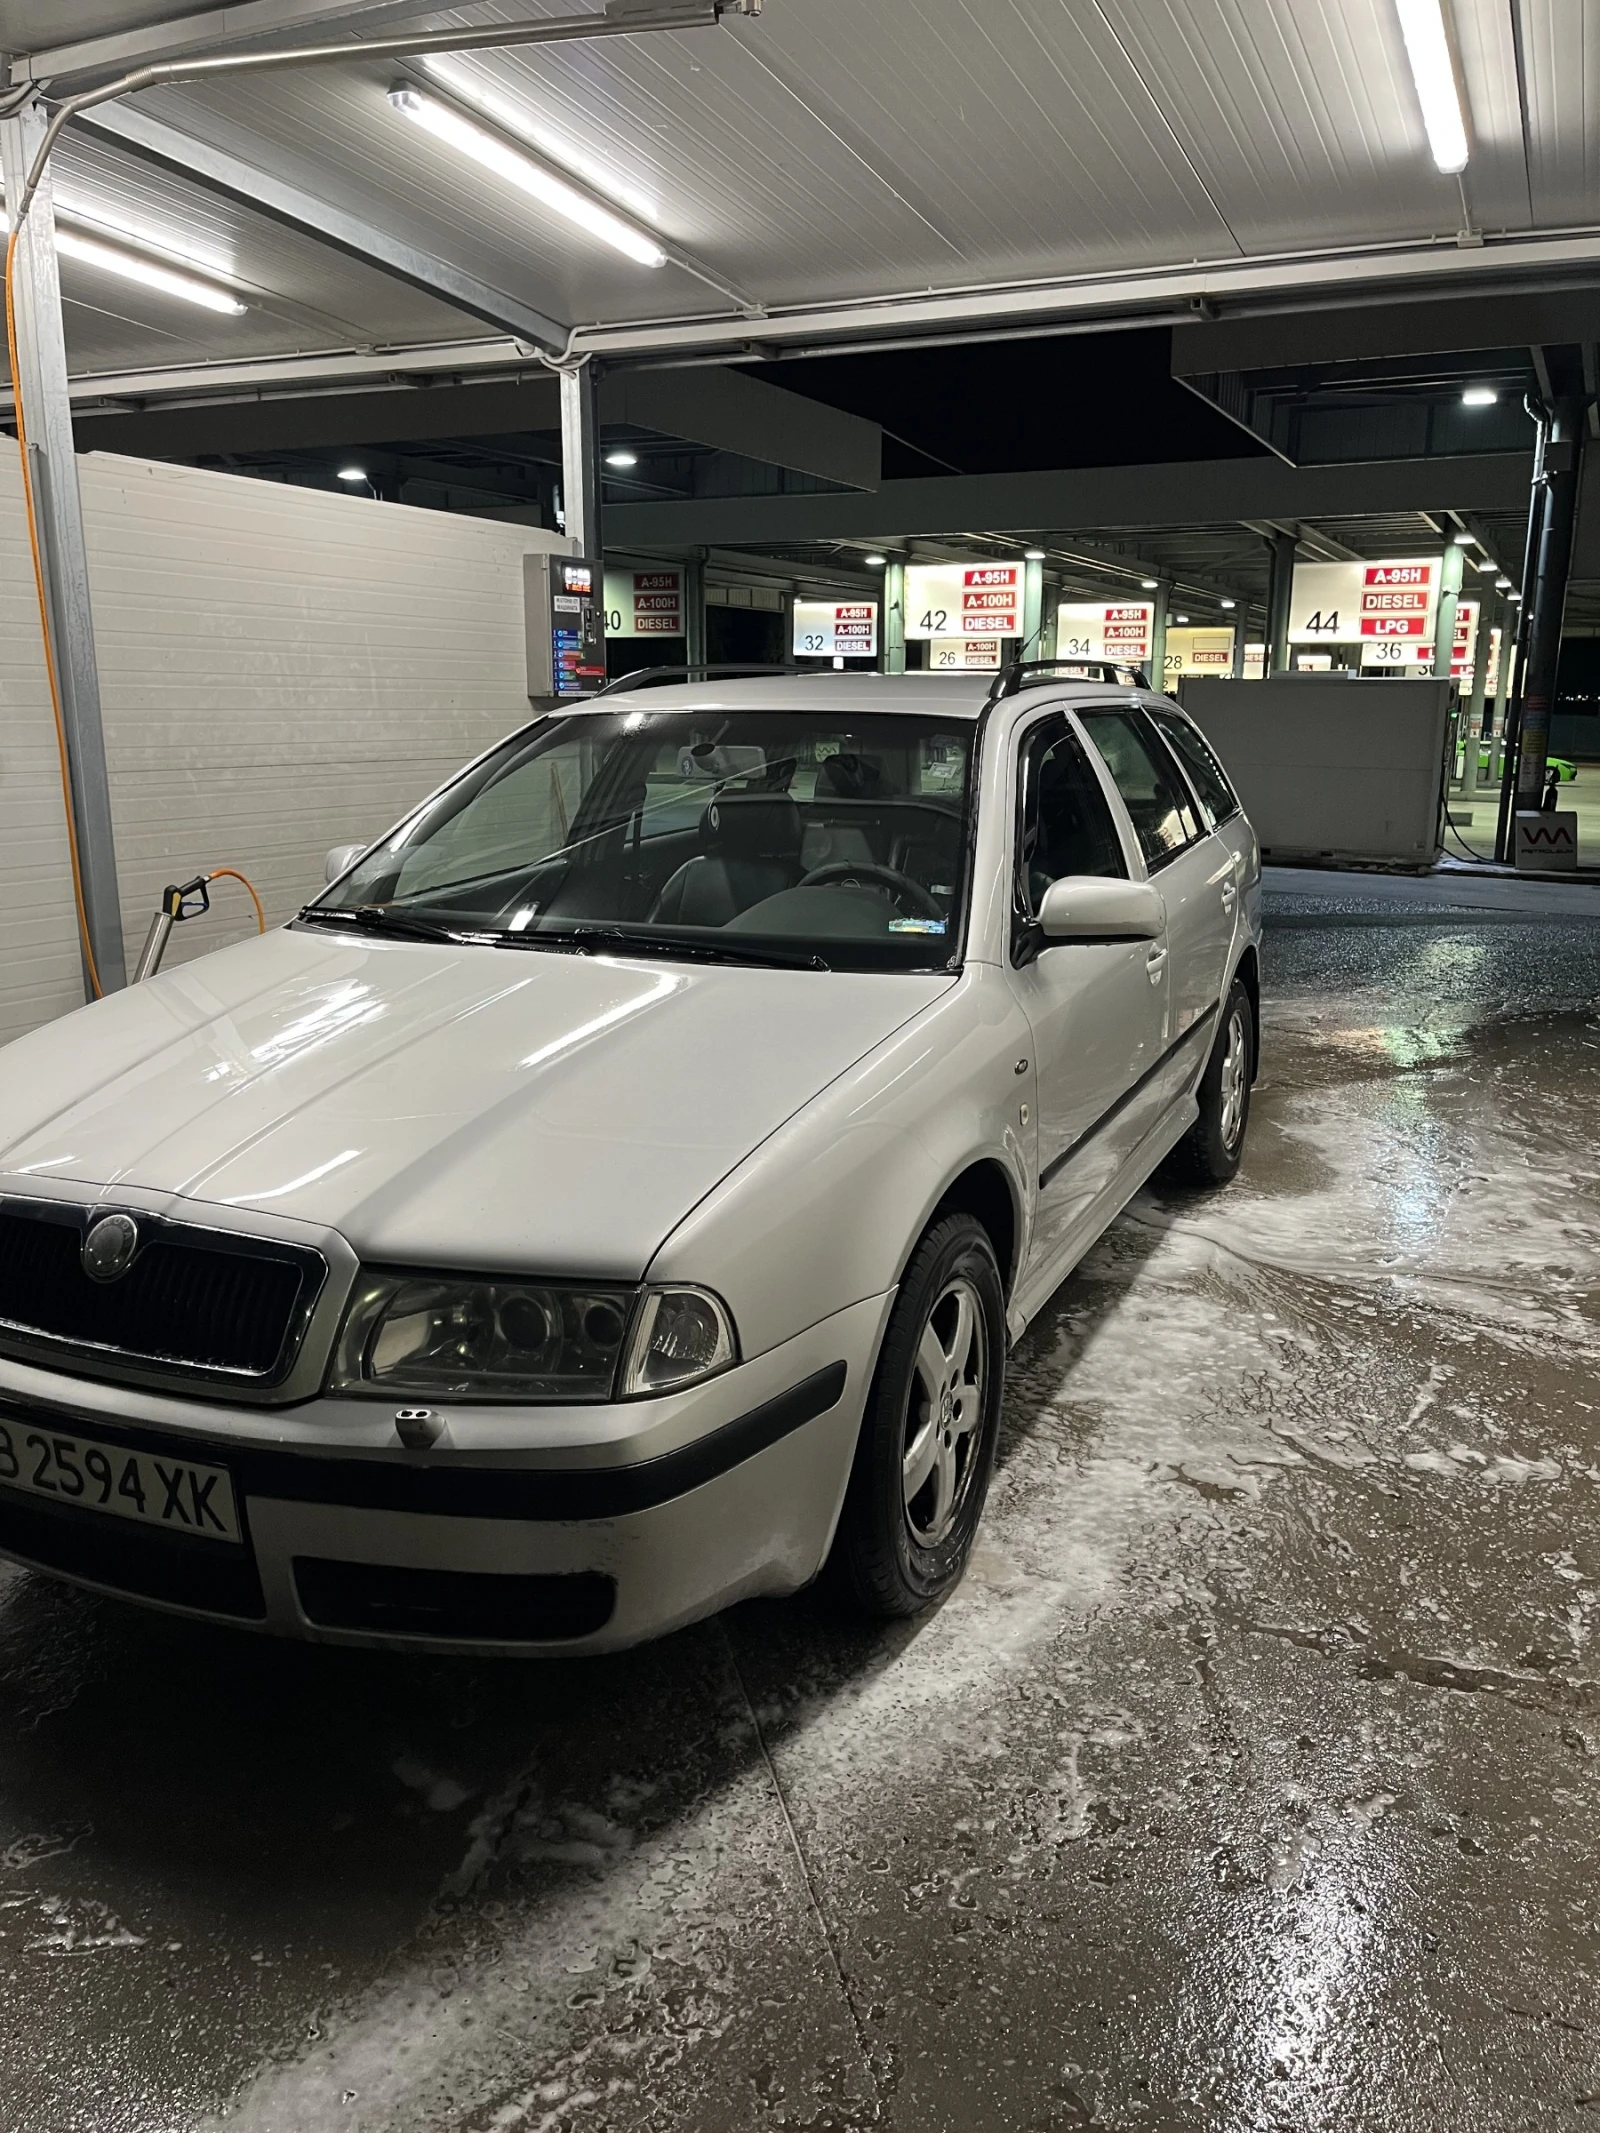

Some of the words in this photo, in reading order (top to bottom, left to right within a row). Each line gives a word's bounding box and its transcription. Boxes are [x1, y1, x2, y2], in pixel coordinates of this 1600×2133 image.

[641, 576, 672, 588] A-95H
[971, 570, 1010, 584] A-95H
[1374, 569, 1421, 584] A-95H
[638, 597, 676, 609] A-100H
[967, 594, 1013, 608] A-100H
[1365, 594, 1423, 609] DIESEL
[840, 608, 867, 618] A-95H
[1111, 609, 1142, 620] A-95H
[638, 618, 676, 629] DIESEL
[920, 610, 947, 631] 42
[965, 616, 1012, 630] DIESEL
[1306, 610, 1340, 634] 44
[1375, 619, 1409, 634] LPG
[837, 625, 870, 635] A-100H
[1107, 627, 1144, 638] A-100H
[804, 634, 824, 651] 32
[836, 640, 869, 651] DIESEL
[967, 642, 995, 652] A-100H
[1068, 638, 1091, 656] 34
[1106, 644, 1144, 656] DIESEL
[1375, 643, 1402, 660] 36
[939, 651, 956, 665] 26
[966, 656, 995, 665] DIESEL
[1164, 655, 1183, 670] 28
[1194, 653, 1226, 663] DIESEL
[26, 1434, 146, 1513] 2594
[154, 1463, 228, 1532] XK
